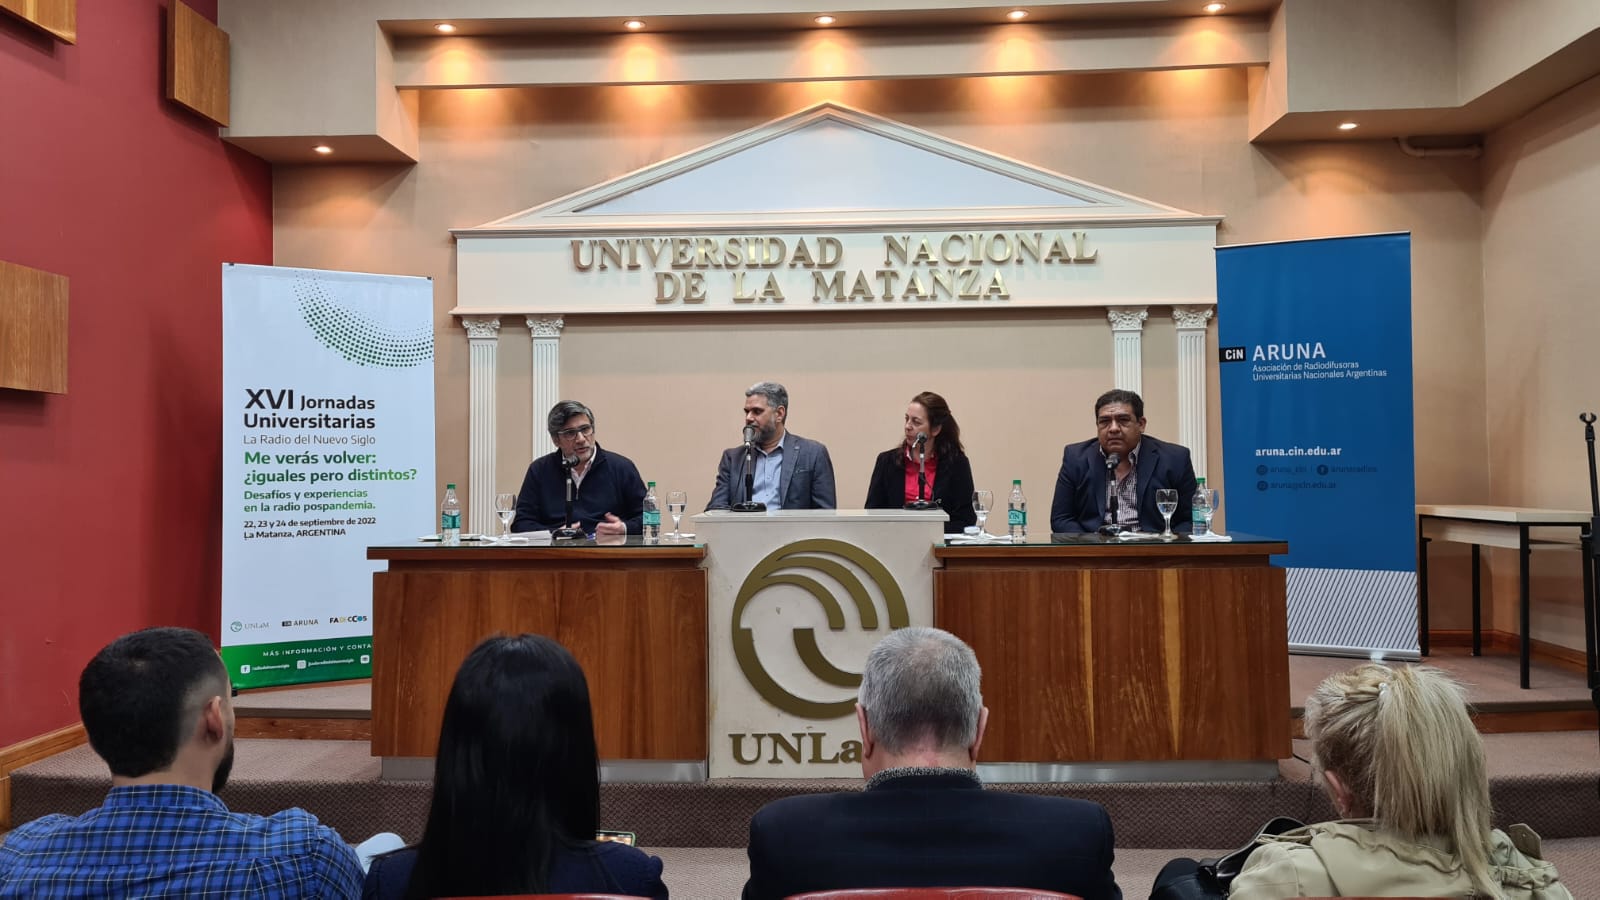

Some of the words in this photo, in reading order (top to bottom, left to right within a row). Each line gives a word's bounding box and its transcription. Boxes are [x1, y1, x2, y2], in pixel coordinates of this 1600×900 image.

[571, 236, 843, 272] UNIVERSIDAD
[884, 231, 1099, 266] NACIONAL
[655, 271, 706, 304] DE
[732, 271, 785, 302] LA
[811, 269, 1011, 302] MATANZA
[1253, 342, 1326, 361] ARUNA
[1252, 364, 1292, 372] Asociación
[1304, 361, 1359, 370] Radiodifusoras
[1253, 372, 1301, 381] Universitarias
[1303, 371, 1344, 379] Nacionales
[1346, 370, 1387, 380] Argentinas
[245, 389, 294, 409] XVI
[300, 395, 376, 411] Jornadas
[244, 413, 376, 428] Universitarias
[243, 435, 257, 444] La
[260, 434, 291, 444] Radio
[294, 434, 310, 444] del
[313, 435, 348, 444] Nuevo
[351, 434, 376, 446] Siglo
[1255, 446, 1342, 456] aruna.cin.edu.ar
[245, 451, 271, 464] Me
[275, 451, 318, 464] verás
[323, 451, 376, 463] volver:
[244, 470, 306, 485] ¿iguales
[310, 471, 343, 484] pero
[348, 469, 417, 481] distintos?
[244, 489, 291, 499] Desafíos
[294, 491, 300, 500] y
[304, 489, 368, 500] experiencias
[261, 503, 270, 512] la
[274, 503, 300, 511] radio
[304, 501, 376, 512] pospandemia.
[244, 521, 256, 529] 22,
[258, 520, 267, 528] 23
[300, 518, 344, 527] septiembre
[346, 517, 356, 525] de
[244, 531, 254, 539] La
[256, 530, 294, 538] Matanza,
[296, 528, 346, 537] ARGENTINA
[282, 645, 337, 656] INFORMACIÓN
[728, 732, 862, 765] UNLa
